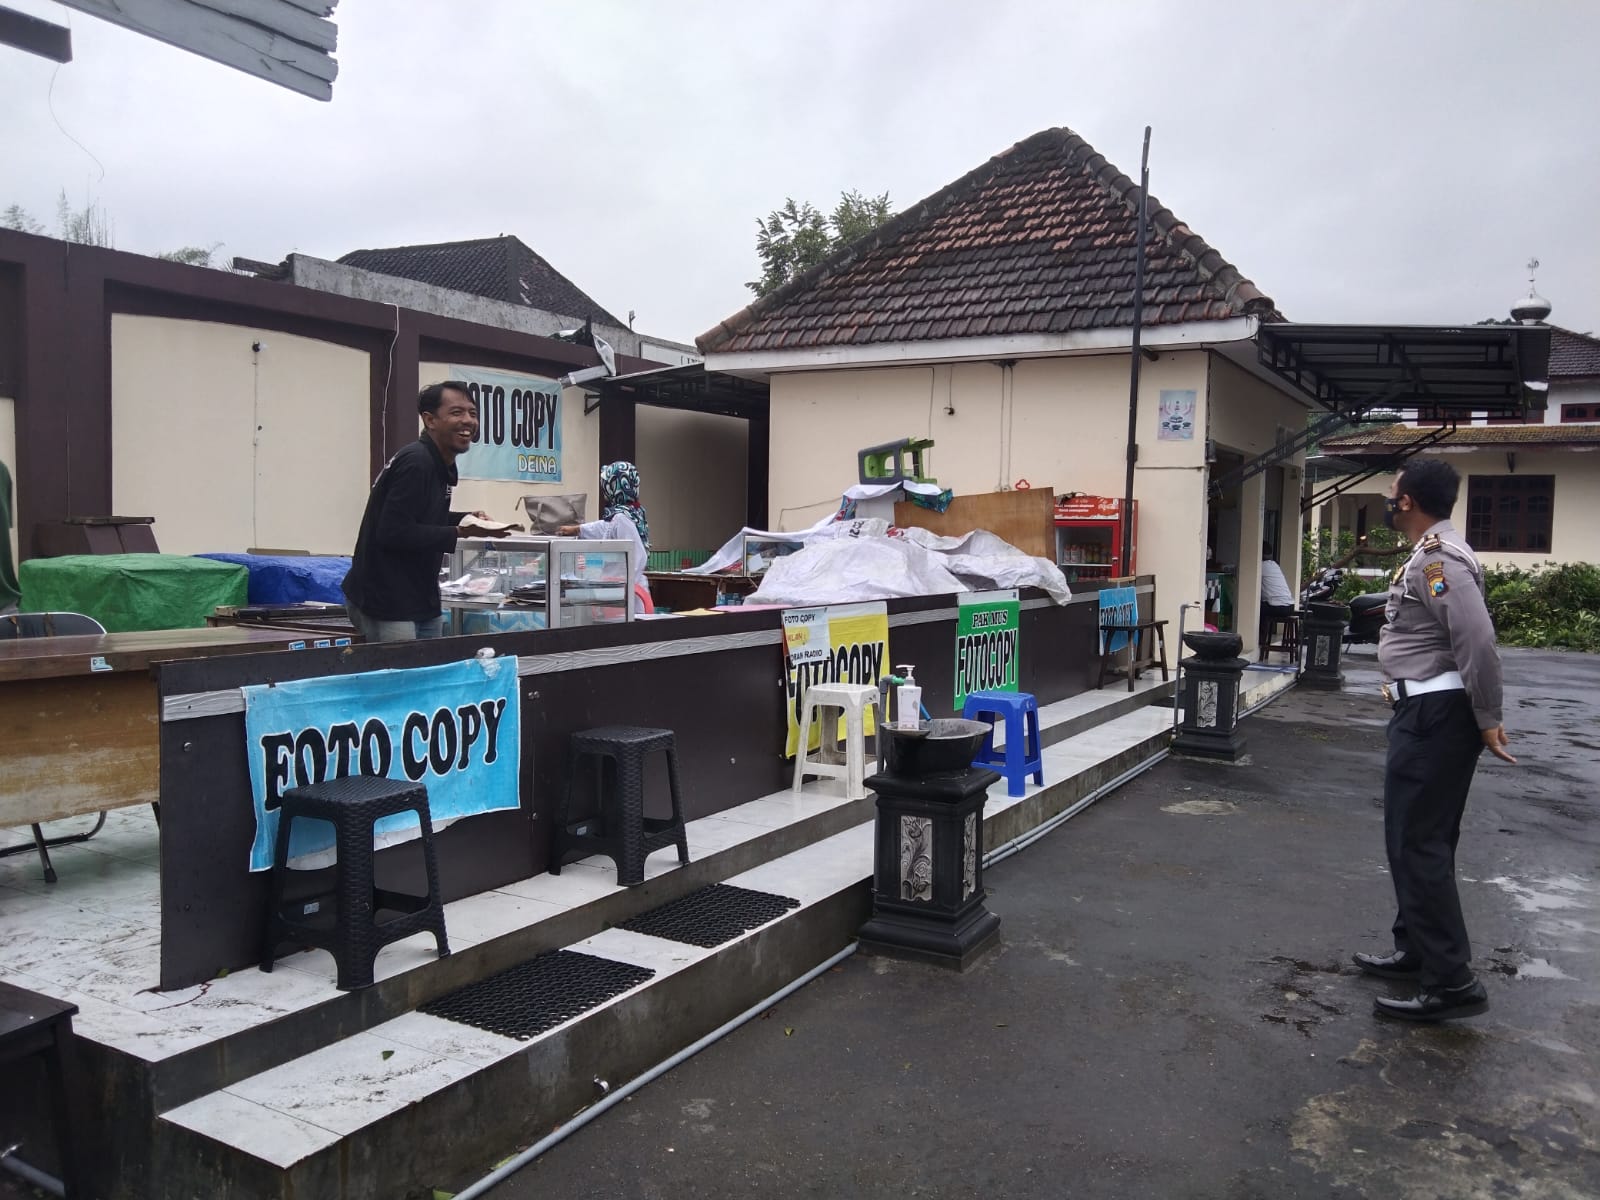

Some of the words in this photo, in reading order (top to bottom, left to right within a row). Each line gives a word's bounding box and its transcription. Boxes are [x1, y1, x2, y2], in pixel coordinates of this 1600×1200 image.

[466, 382, 505, 446] OTO
[511, 388, 558, 450] COPY
[518, 454, 558, 474] DEINA
[784, 615, 799, 624] FOTO
[972, 612, 989, 628] PAK
[991, 610, 1008, 625] MUS
[956, 628, 1018, 697] FOTOCOPY
[261, 718, 392, 811] FOTO
[402, 698, 506, 782] COPY
